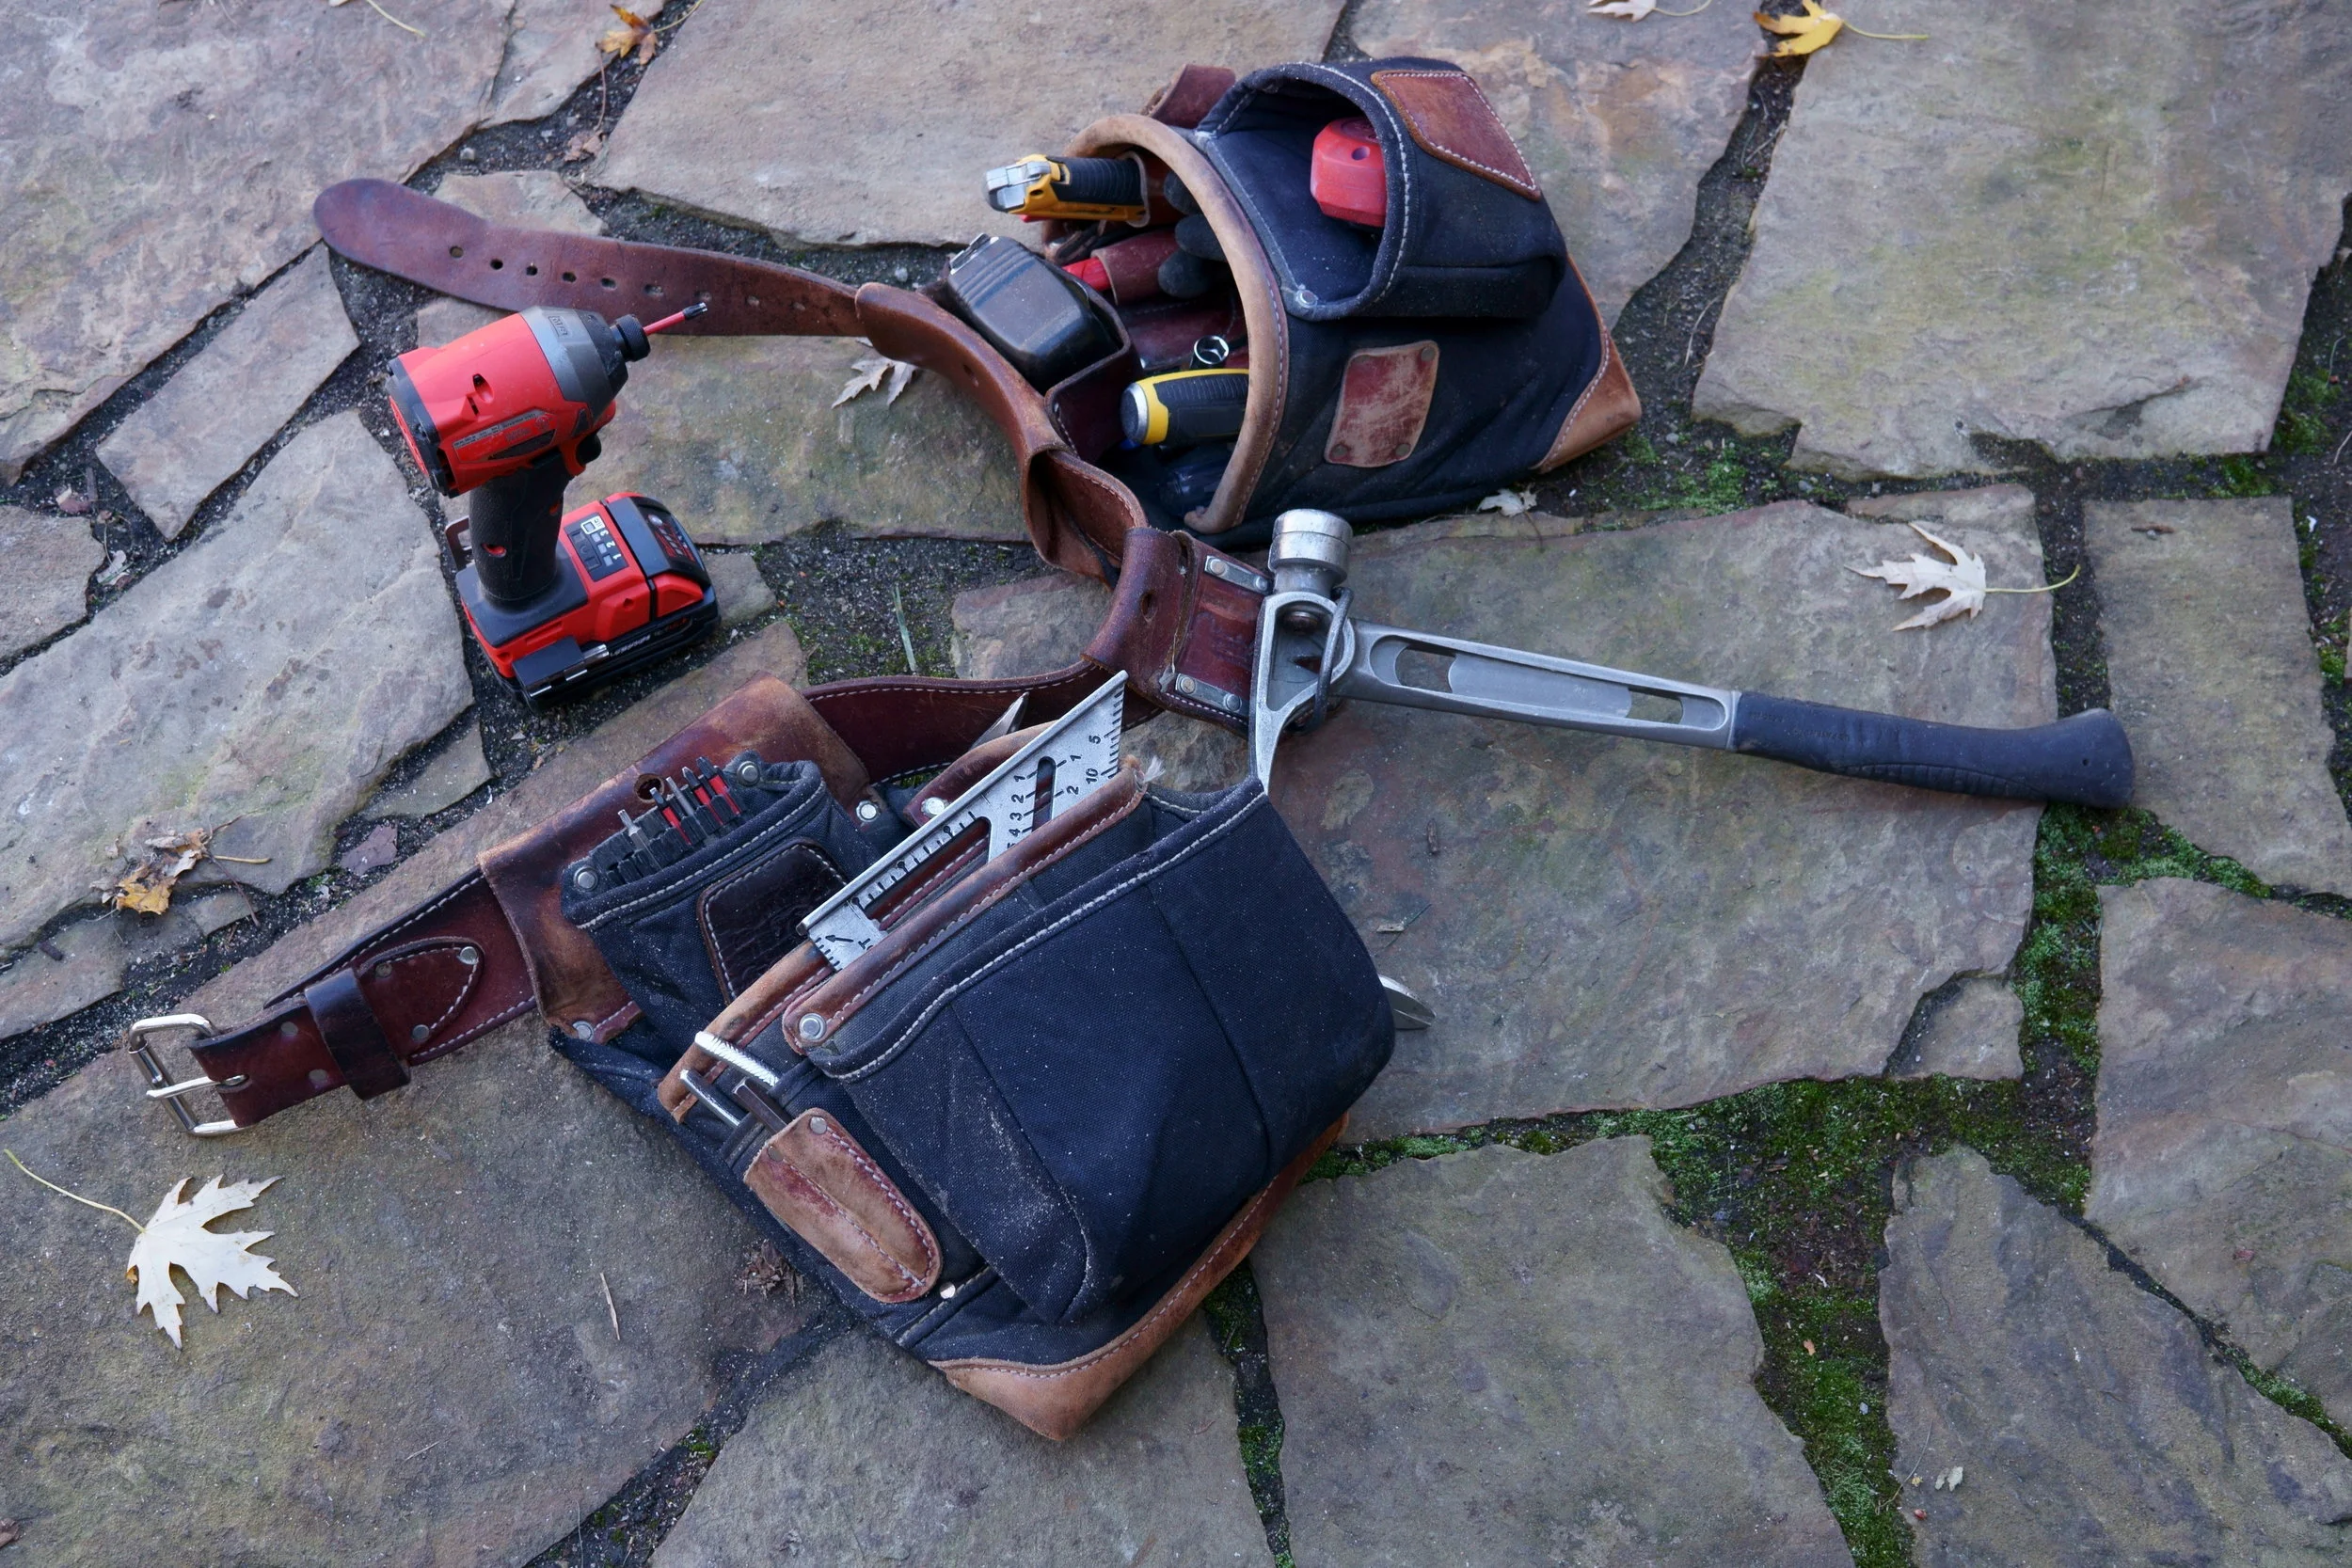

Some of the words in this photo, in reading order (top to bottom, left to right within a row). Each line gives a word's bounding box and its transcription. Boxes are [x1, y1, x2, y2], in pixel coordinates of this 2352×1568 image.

[1089, 735, 1102, 744] 5
[1086, 768, 1099, 784] 10
[1066, 785, 1079, 795] 2
[1010, 794, 1025, 803] 2
[1009, 812, 1022, 821] 3
[1009, 828, 1021, 837] 4
